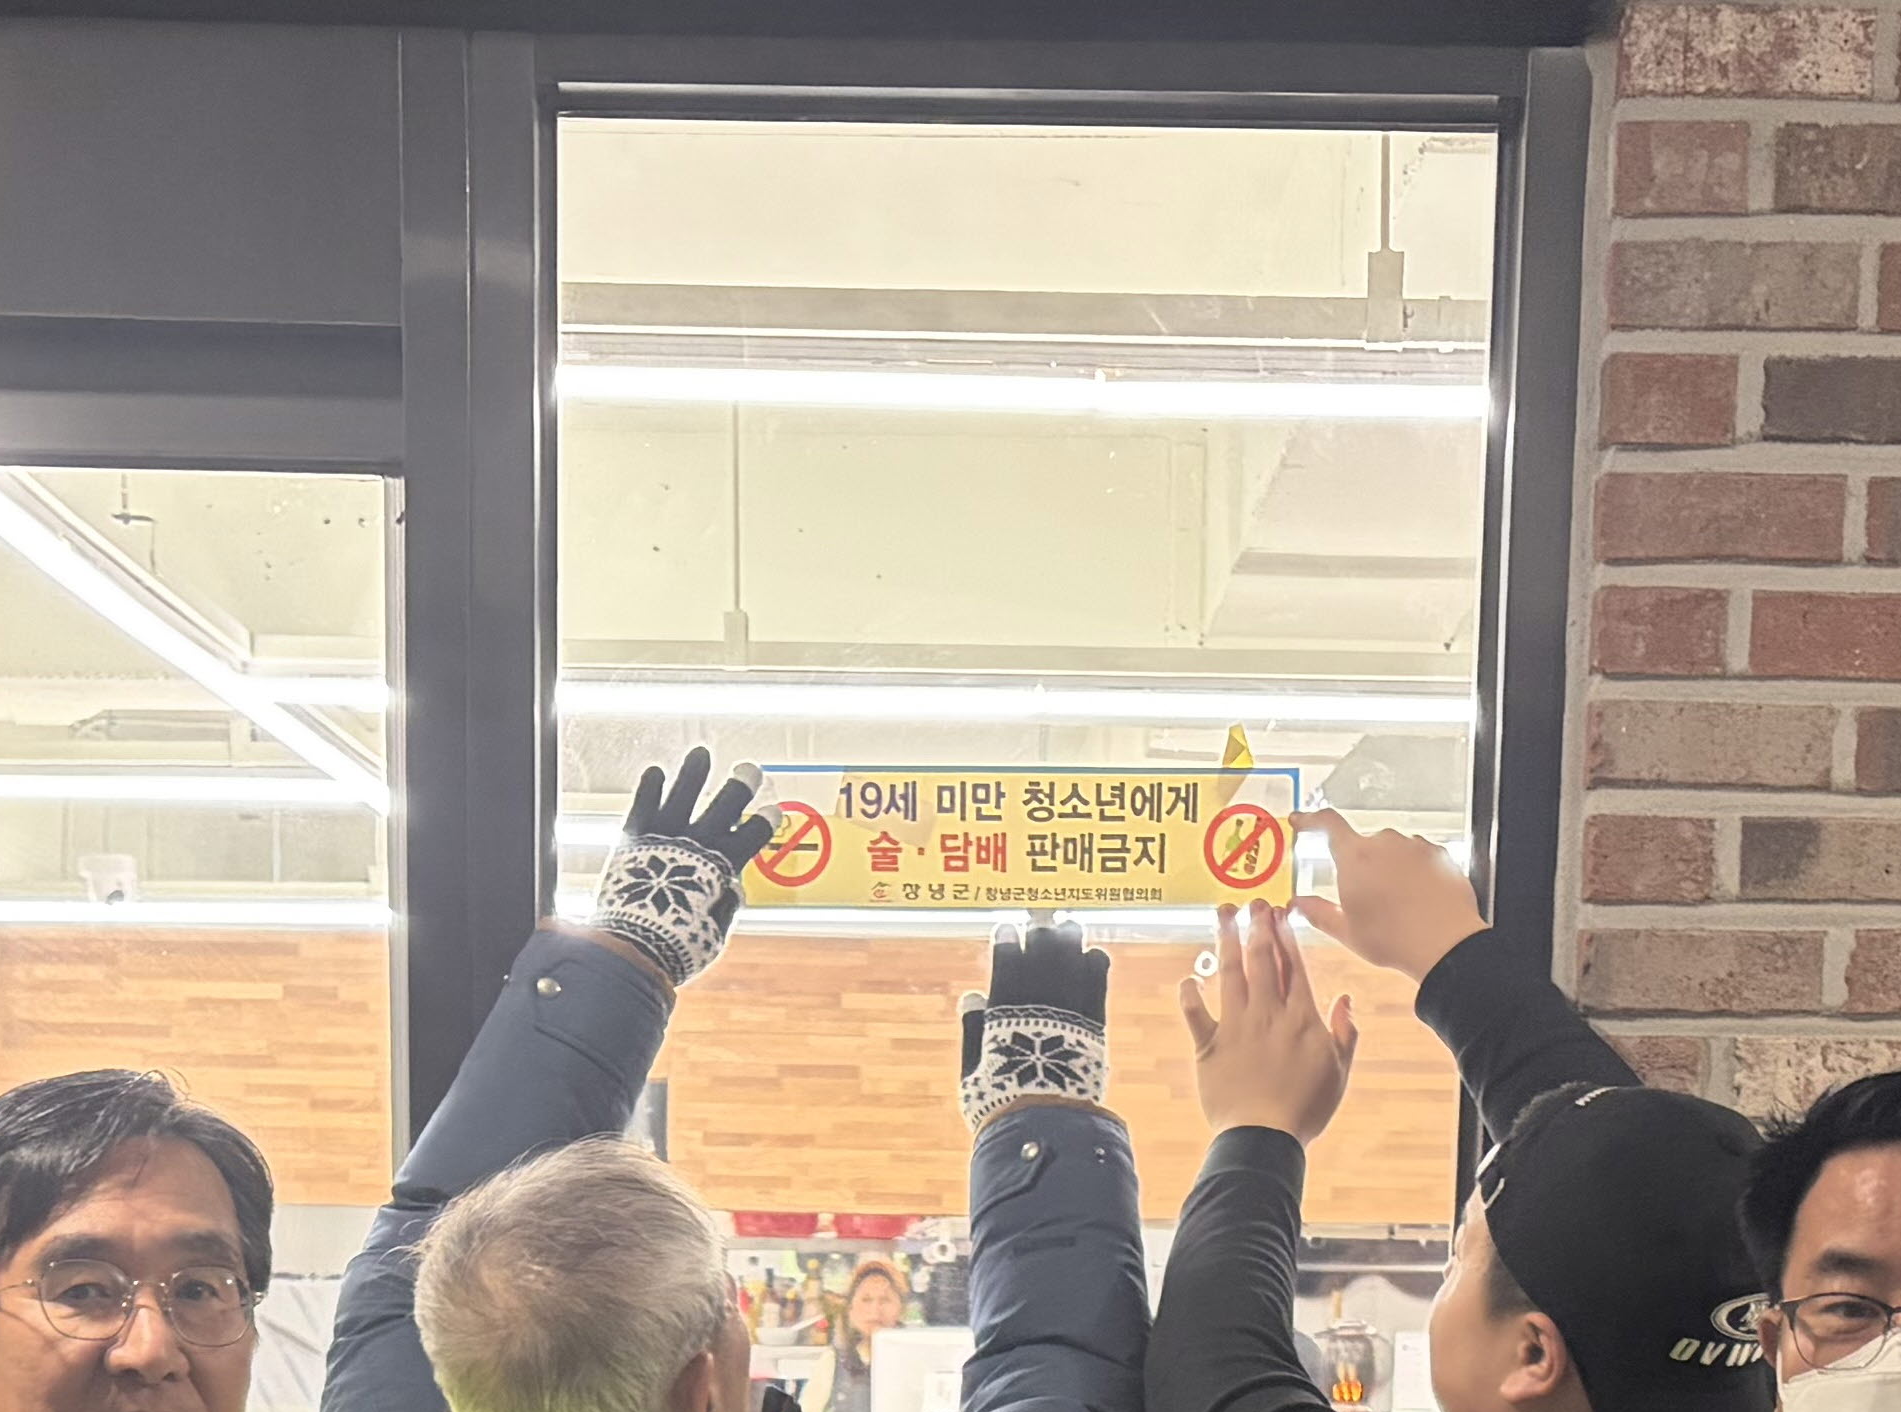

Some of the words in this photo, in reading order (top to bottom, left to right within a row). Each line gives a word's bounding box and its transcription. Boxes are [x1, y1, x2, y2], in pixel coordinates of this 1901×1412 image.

[839, 781, 918, 822] 19세
[937, 780, 1006, 822] 미만
[1022, 781, 1199, 824] 청소년에게
[1026, 832, 1166, 874] 판매금지
